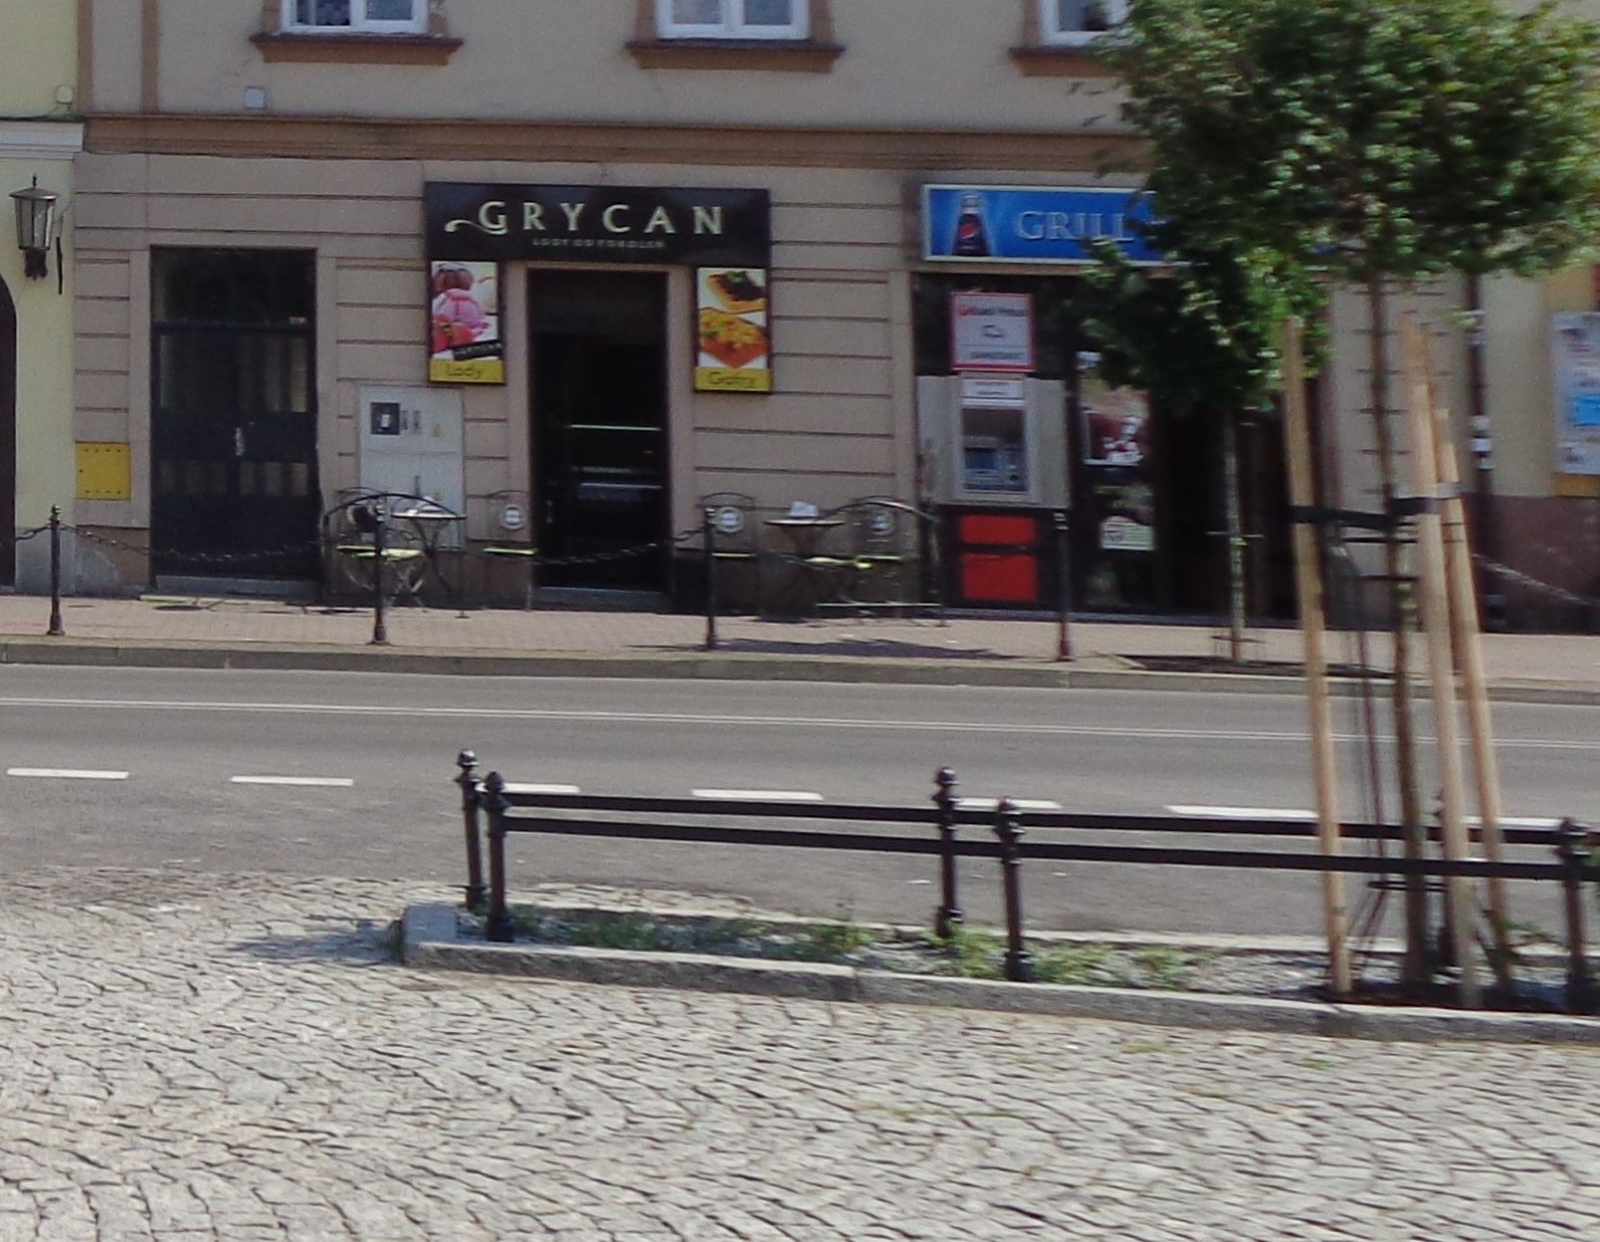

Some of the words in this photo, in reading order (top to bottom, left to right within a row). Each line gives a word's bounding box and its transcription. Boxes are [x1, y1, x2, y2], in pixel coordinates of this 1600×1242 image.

[445, 200, 723, 236] GRYCAN
[1014, 210, 1135, 242] GRILL
[446, 361, 484, 380] Lody
